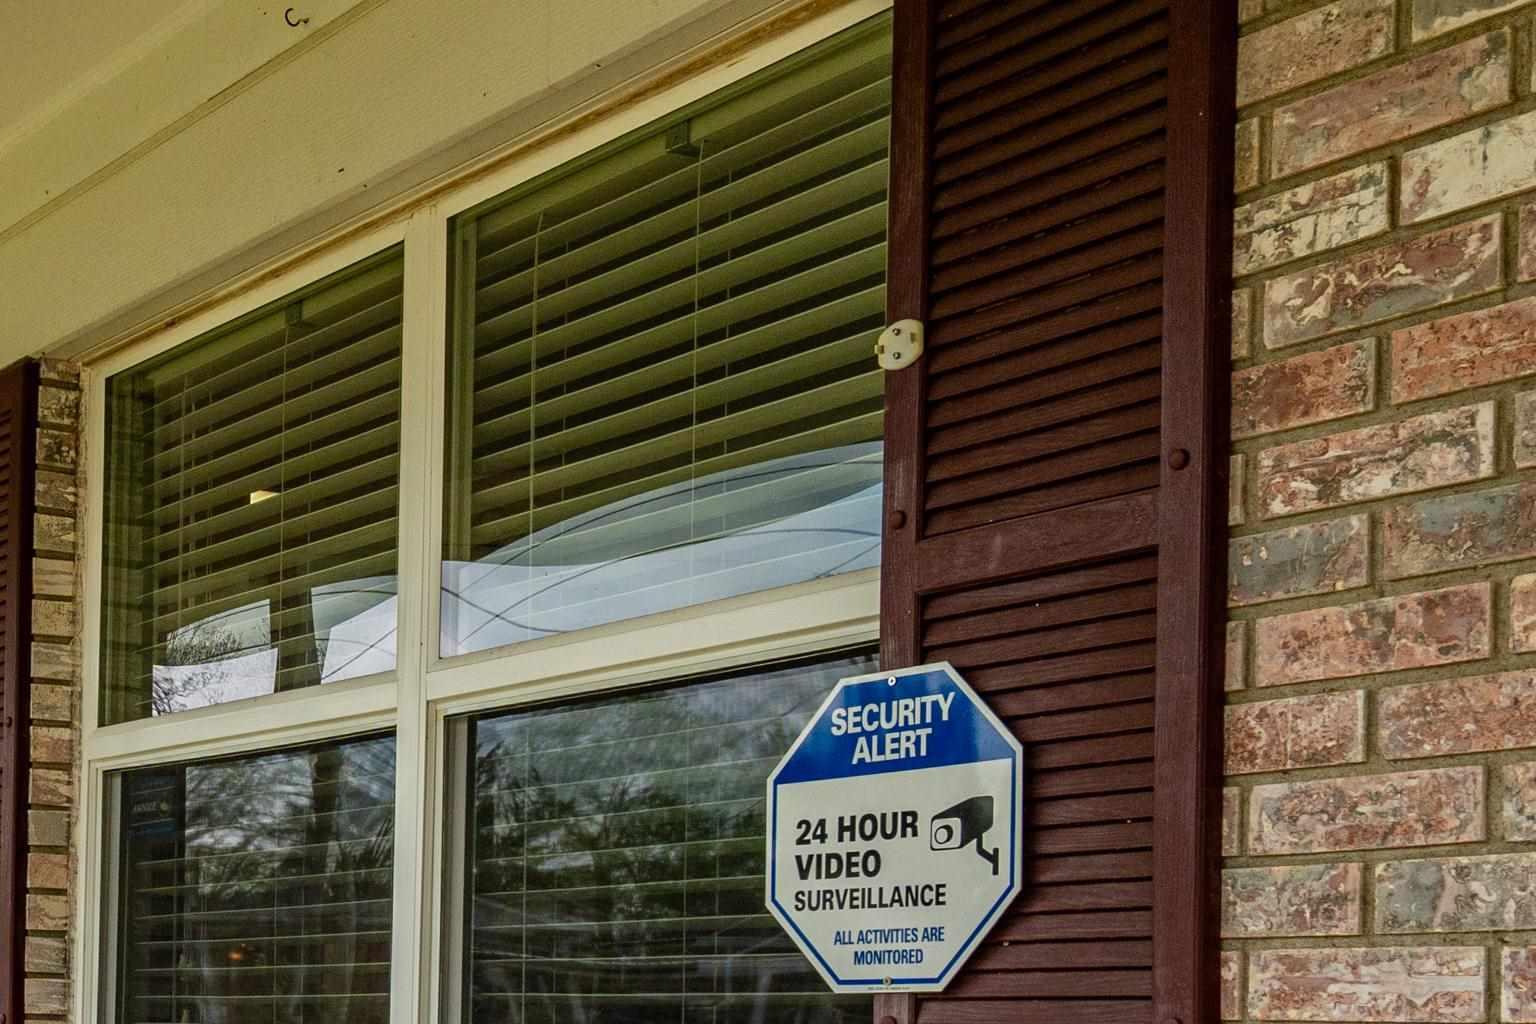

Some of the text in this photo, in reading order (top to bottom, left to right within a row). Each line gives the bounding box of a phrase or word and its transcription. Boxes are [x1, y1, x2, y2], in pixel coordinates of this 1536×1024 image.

[831, 692, 955, 736] SECURITY
[851, 728, 932, 764] ALERT
[795, 810, 919, 845] 24 HOUR
[795, 850, 881, 880] VIDEO
[794, 884, 947, 911] SURVEILLANCE
[834, 926, 945, 945] ALL ACTIVITIES ARE
[853, 949, 924, 966] MONITORED
